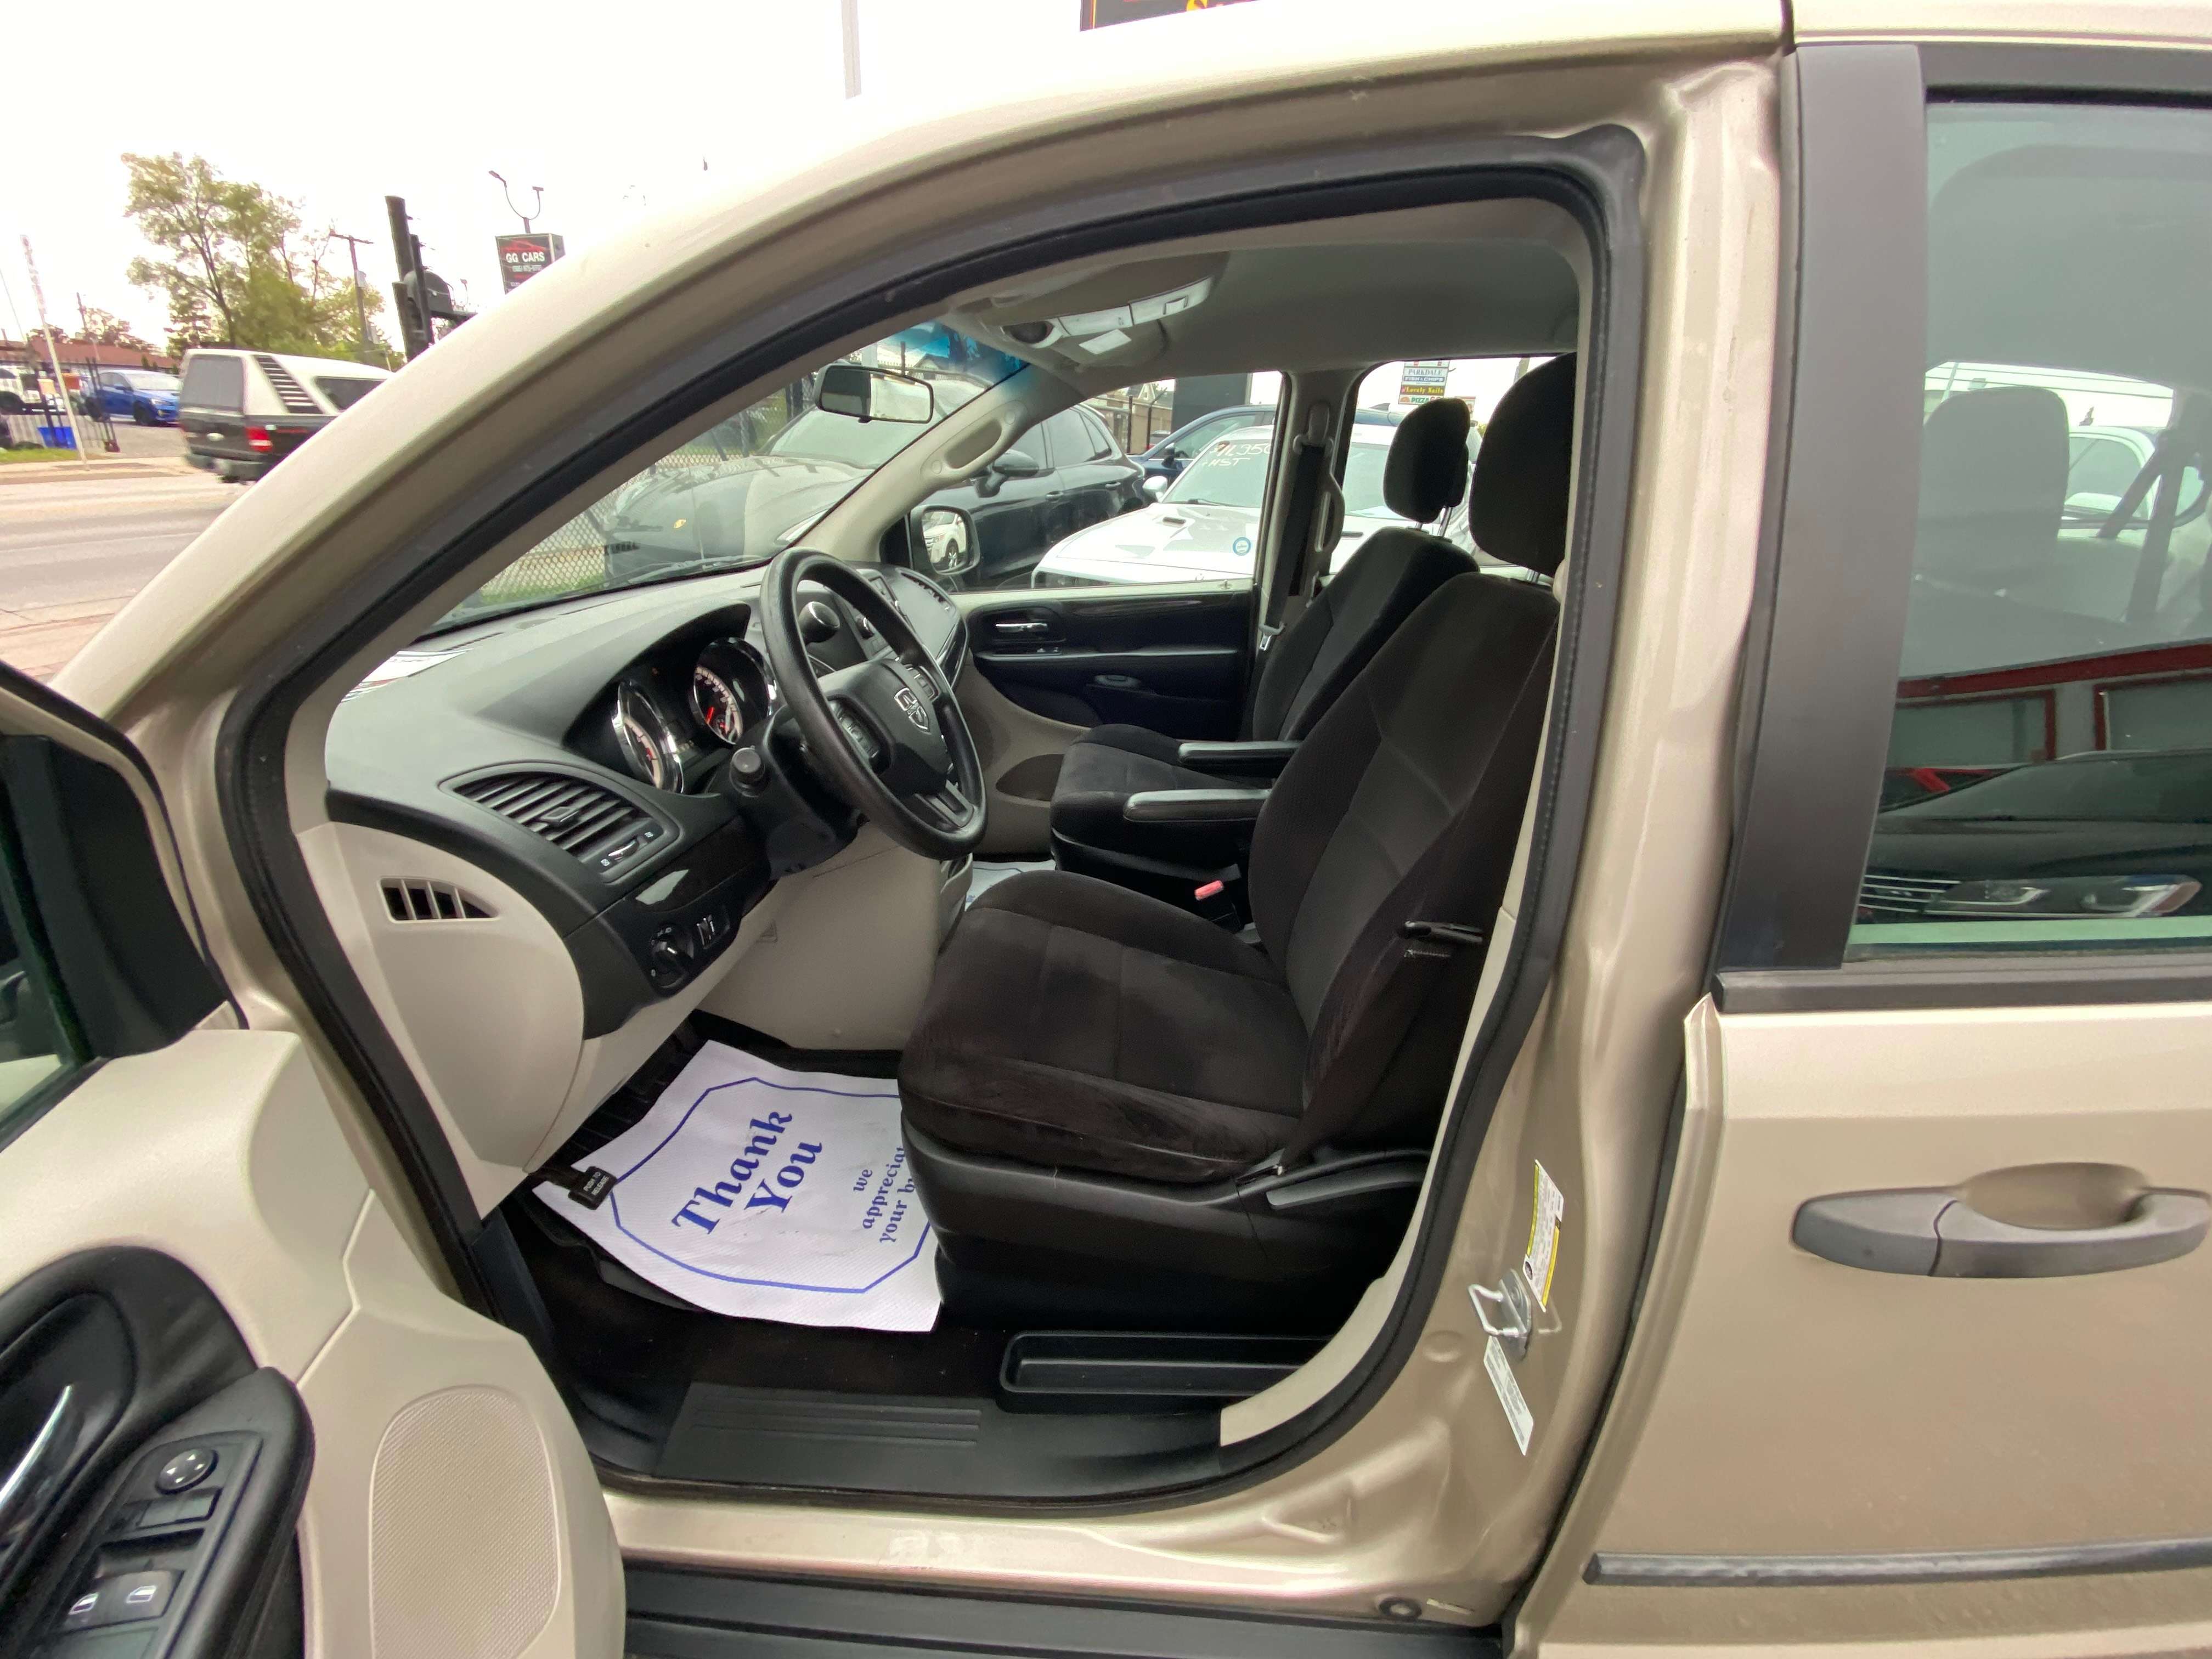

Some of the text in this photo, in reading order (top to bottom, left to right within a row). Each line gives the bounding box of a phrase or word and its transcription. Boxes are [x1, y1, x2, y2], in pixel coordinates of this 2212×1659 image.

[522, 251, 545, 262] CARS
[583, 1178, 595, 1192] PUSH
[591, 1175, 610, 1195] RELEASE
[671, 1111, 793, 1234] Thank
[744, 1142, 822, 1213] You
[853, 1169, 873, 1192] we
[862, 1146, 905, 1229] appreciat
[879, 1199, 907, 1243] your
